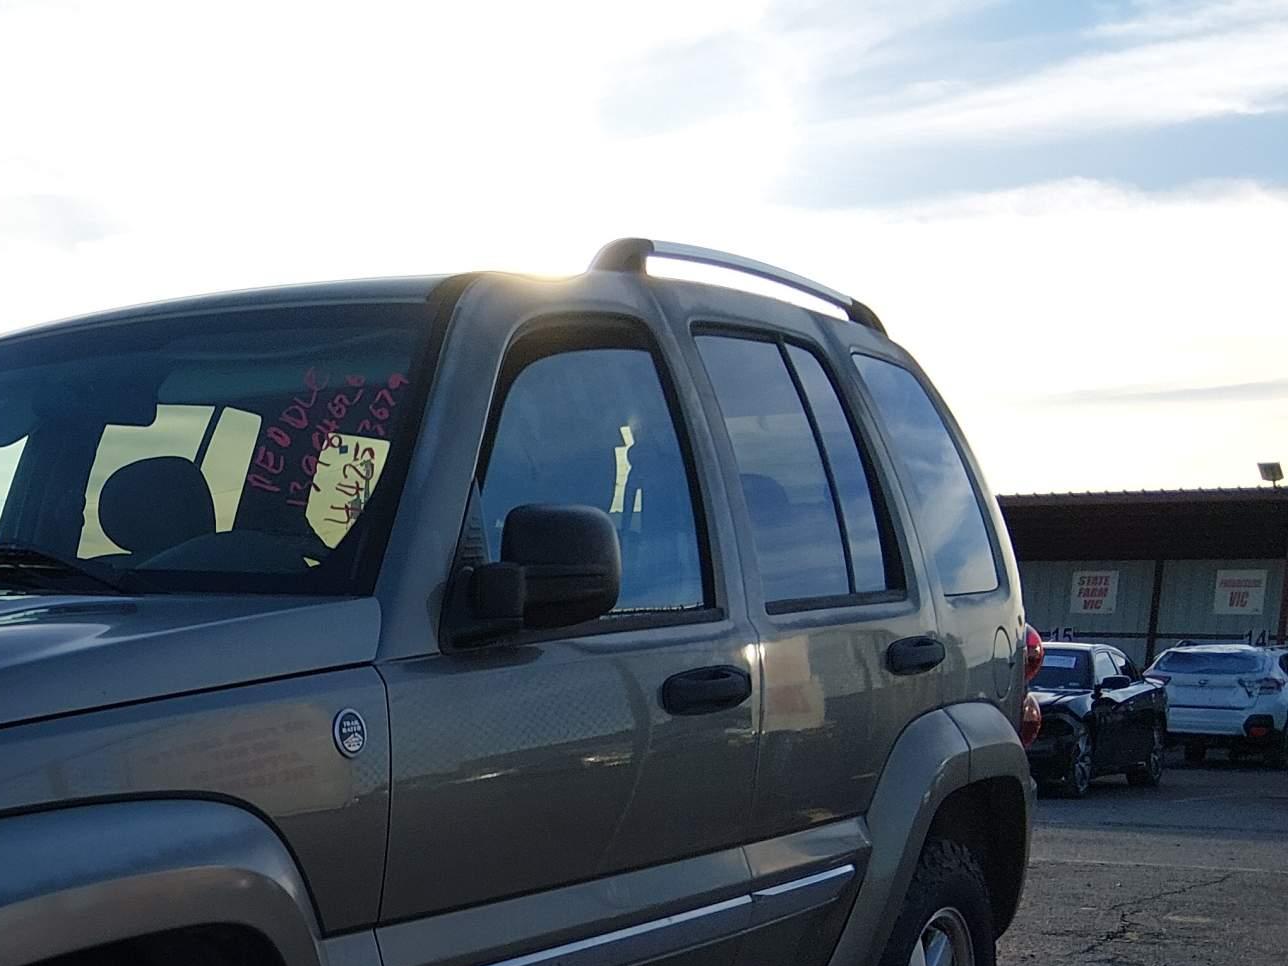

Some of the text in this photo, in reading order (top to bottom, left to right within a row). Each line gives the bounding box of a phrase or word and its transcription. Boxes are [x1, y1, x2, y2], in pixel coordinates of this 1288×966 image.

[1078, 575, 1111, 586] STATE
[1078, 587, 1109, 598] FARM
[1083, 599, 1104, 610] VIC
[1229, 591, 1249, 608] VIC
